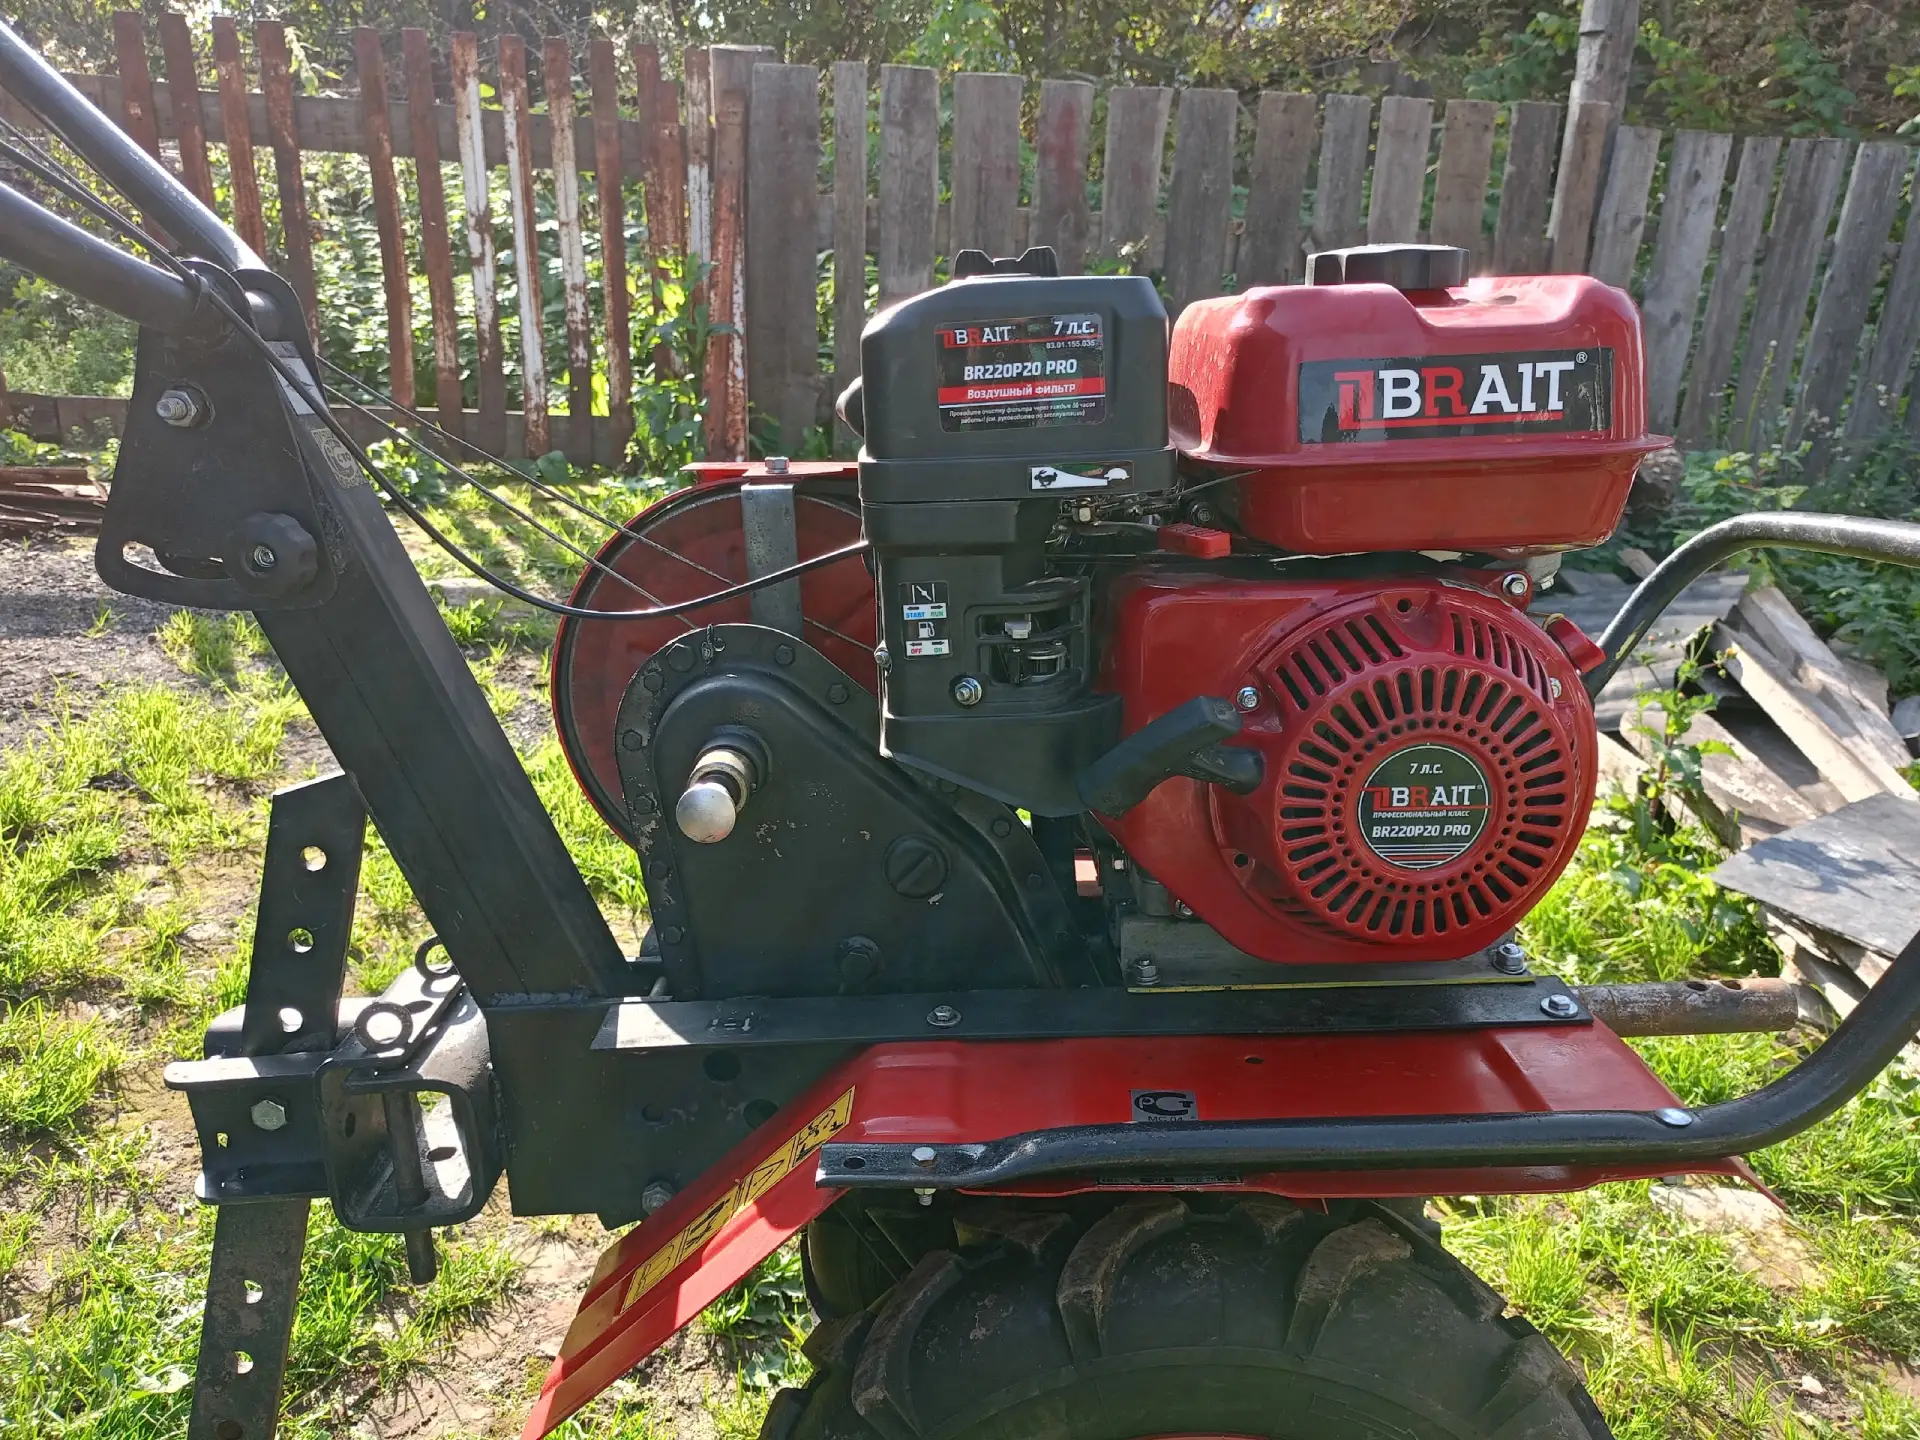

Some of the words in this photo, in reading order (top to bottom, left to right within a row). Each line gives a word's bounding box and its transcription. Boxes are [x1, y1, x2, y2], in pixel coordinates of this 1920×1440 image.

[954, 326, 1012, 345] BRAIT
[1053, 321, 1063, 336] 7
[964, 363, 1042, 381] BR220P20
[1045, 358, 1078, 375] PRO
[1378, 361, 1575, 419] BRAIT
[905, 611, 926, 619] START
[1409, 763, 1419, 775] 7
[1391, 785, 1476, 807] BRAIT
[1372, 809, 1447, 819] ПРОФЕССИОНАЛЬНЫЙ
[1447, 810, 1471, 818] КЛАСС
[1371, 825, 1441, 838] BR220P20
[1442, 824, 1472, 837] PRO
